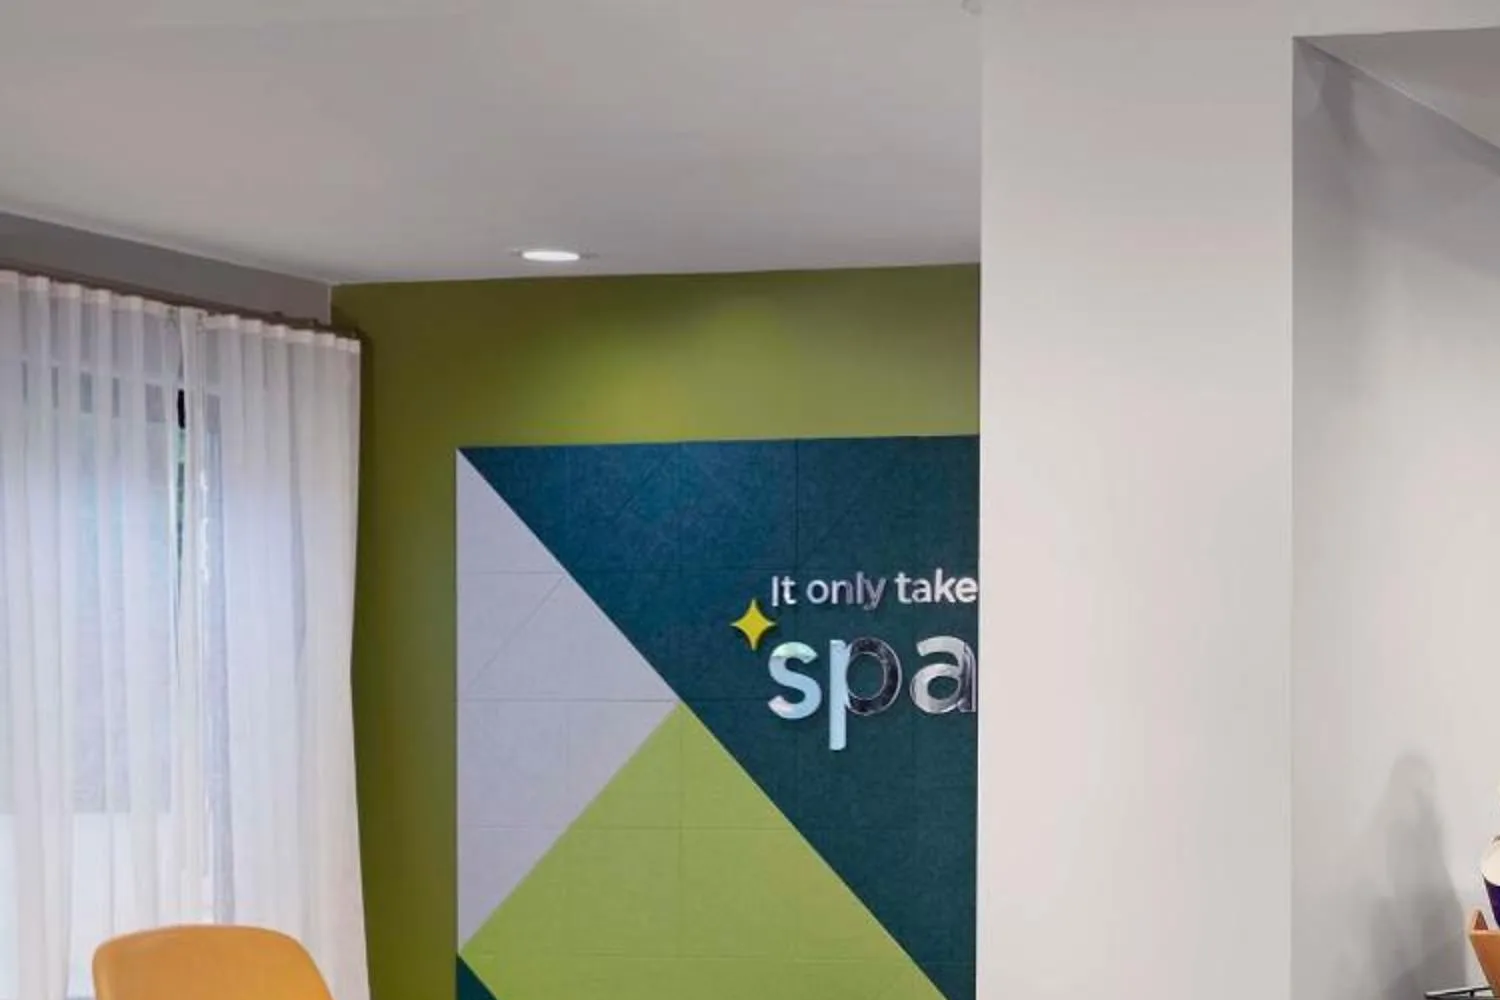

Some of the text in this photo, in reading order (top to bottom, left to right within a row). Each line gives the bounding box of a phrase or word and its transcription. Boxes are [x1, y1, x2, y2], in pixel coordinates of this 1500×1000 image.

[771, 567, 978, 611] It only take
[768, 635, 977, 751] spa
